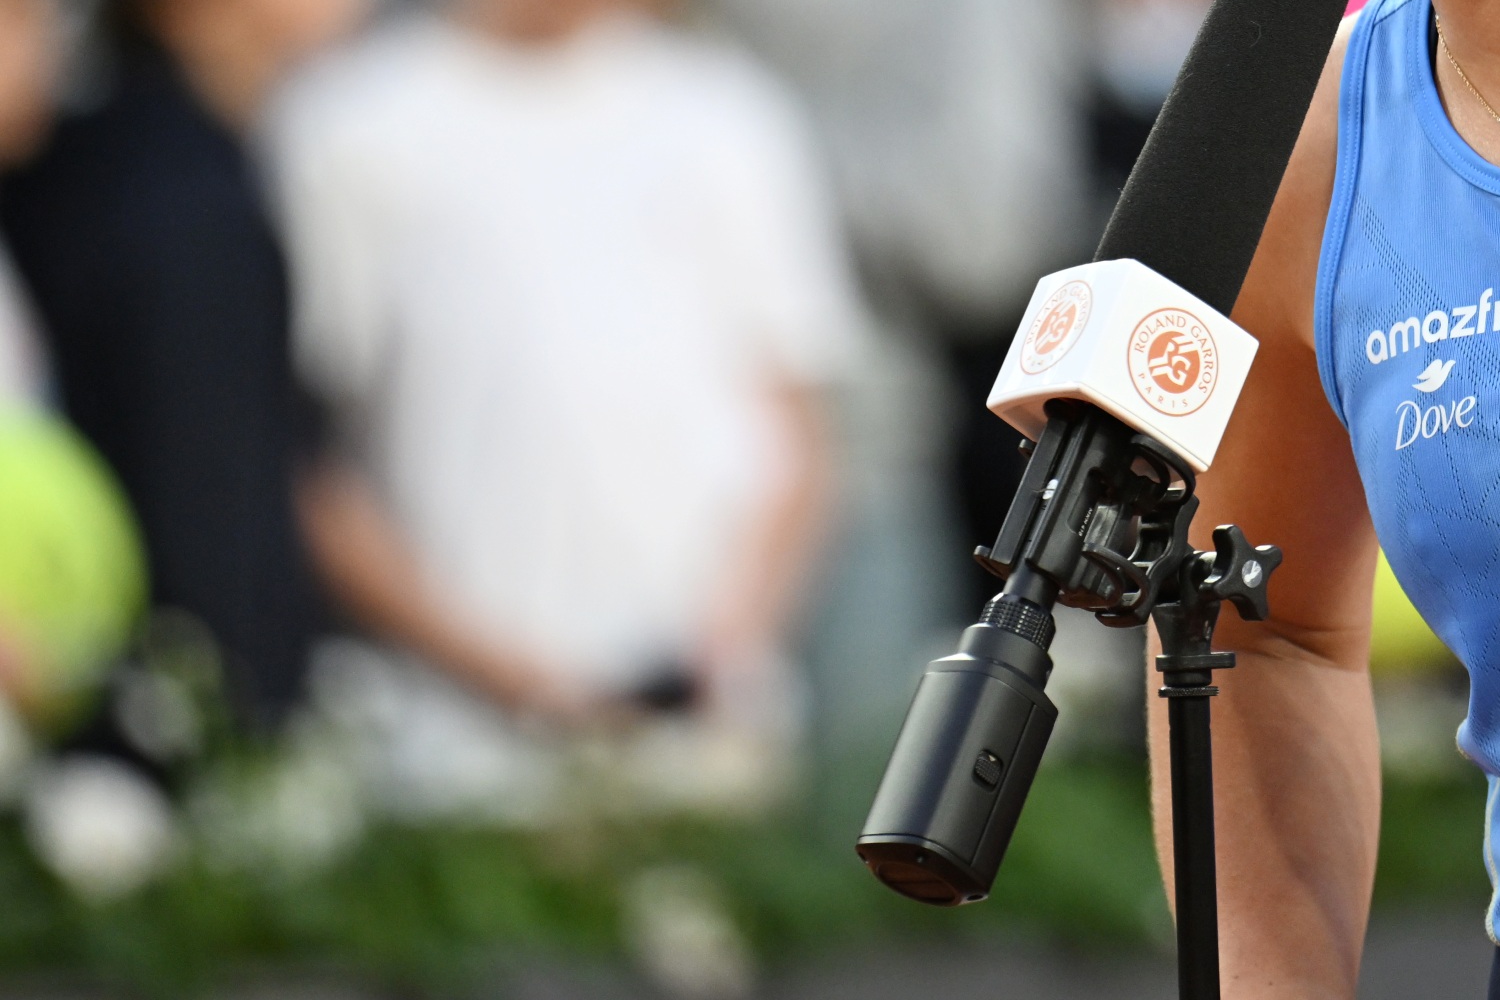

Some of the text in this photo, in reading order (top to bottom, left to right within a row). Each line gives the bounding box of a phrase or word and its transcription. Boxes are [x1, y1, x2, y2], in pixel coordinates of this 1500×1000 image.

[1134, 315, 1213, 393] ROLAND GARROS
[1138, 373, 1188, 408] PARIS
[1395, 396, 1476, 450] Dove
